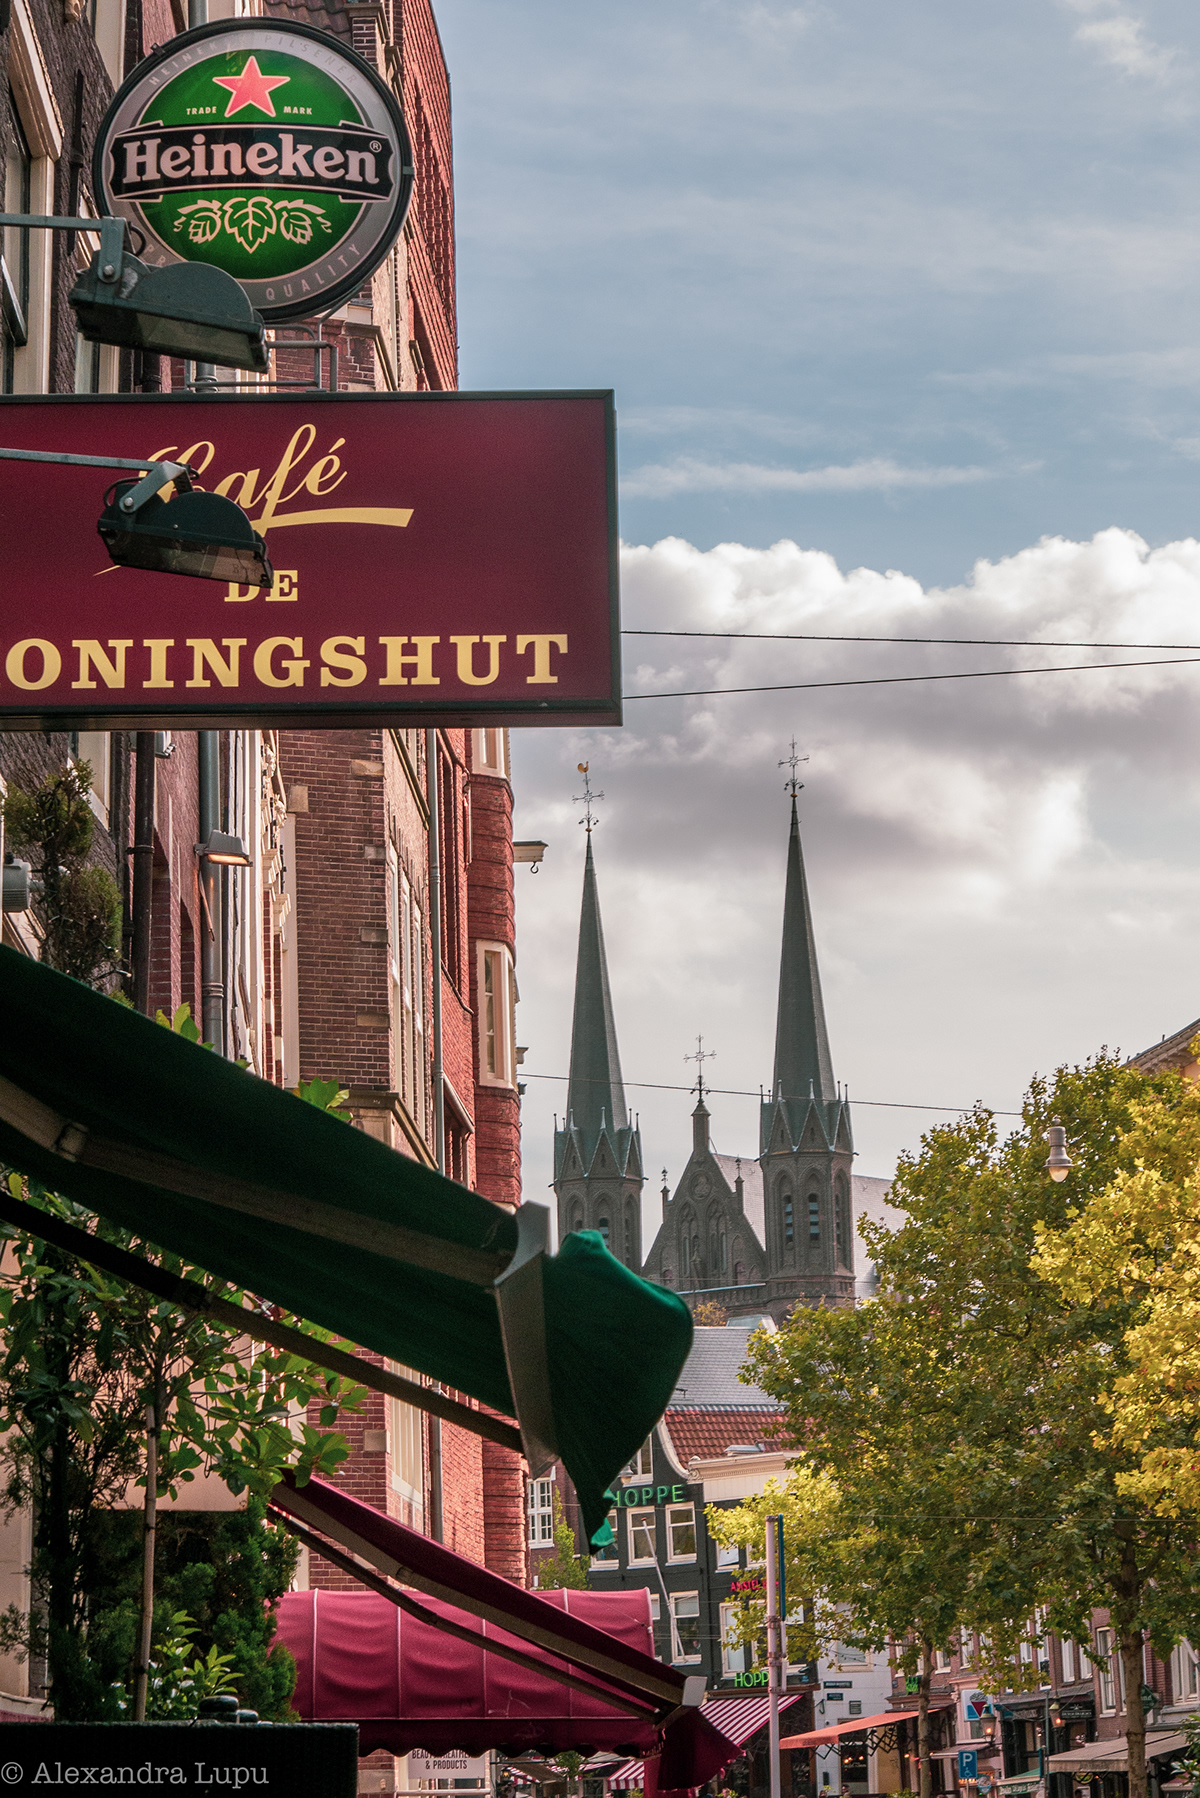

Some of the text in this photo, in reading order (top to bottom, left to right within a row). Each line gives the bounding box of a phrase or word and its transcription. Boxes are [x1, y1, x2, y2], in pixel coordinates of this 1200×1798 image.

[186, 106, 313, 115] TRADE MARK
[266, 244, 360, 301] QUALITY
[224, 569, 299, 602] DE
[730, 1579, 761, 1591] AMSTEL
[734, 1671, 769, 1687] HOPP
[433, 1760, 468, 1770] PRODUCTS
[962, 1752, 973, 1767] P
